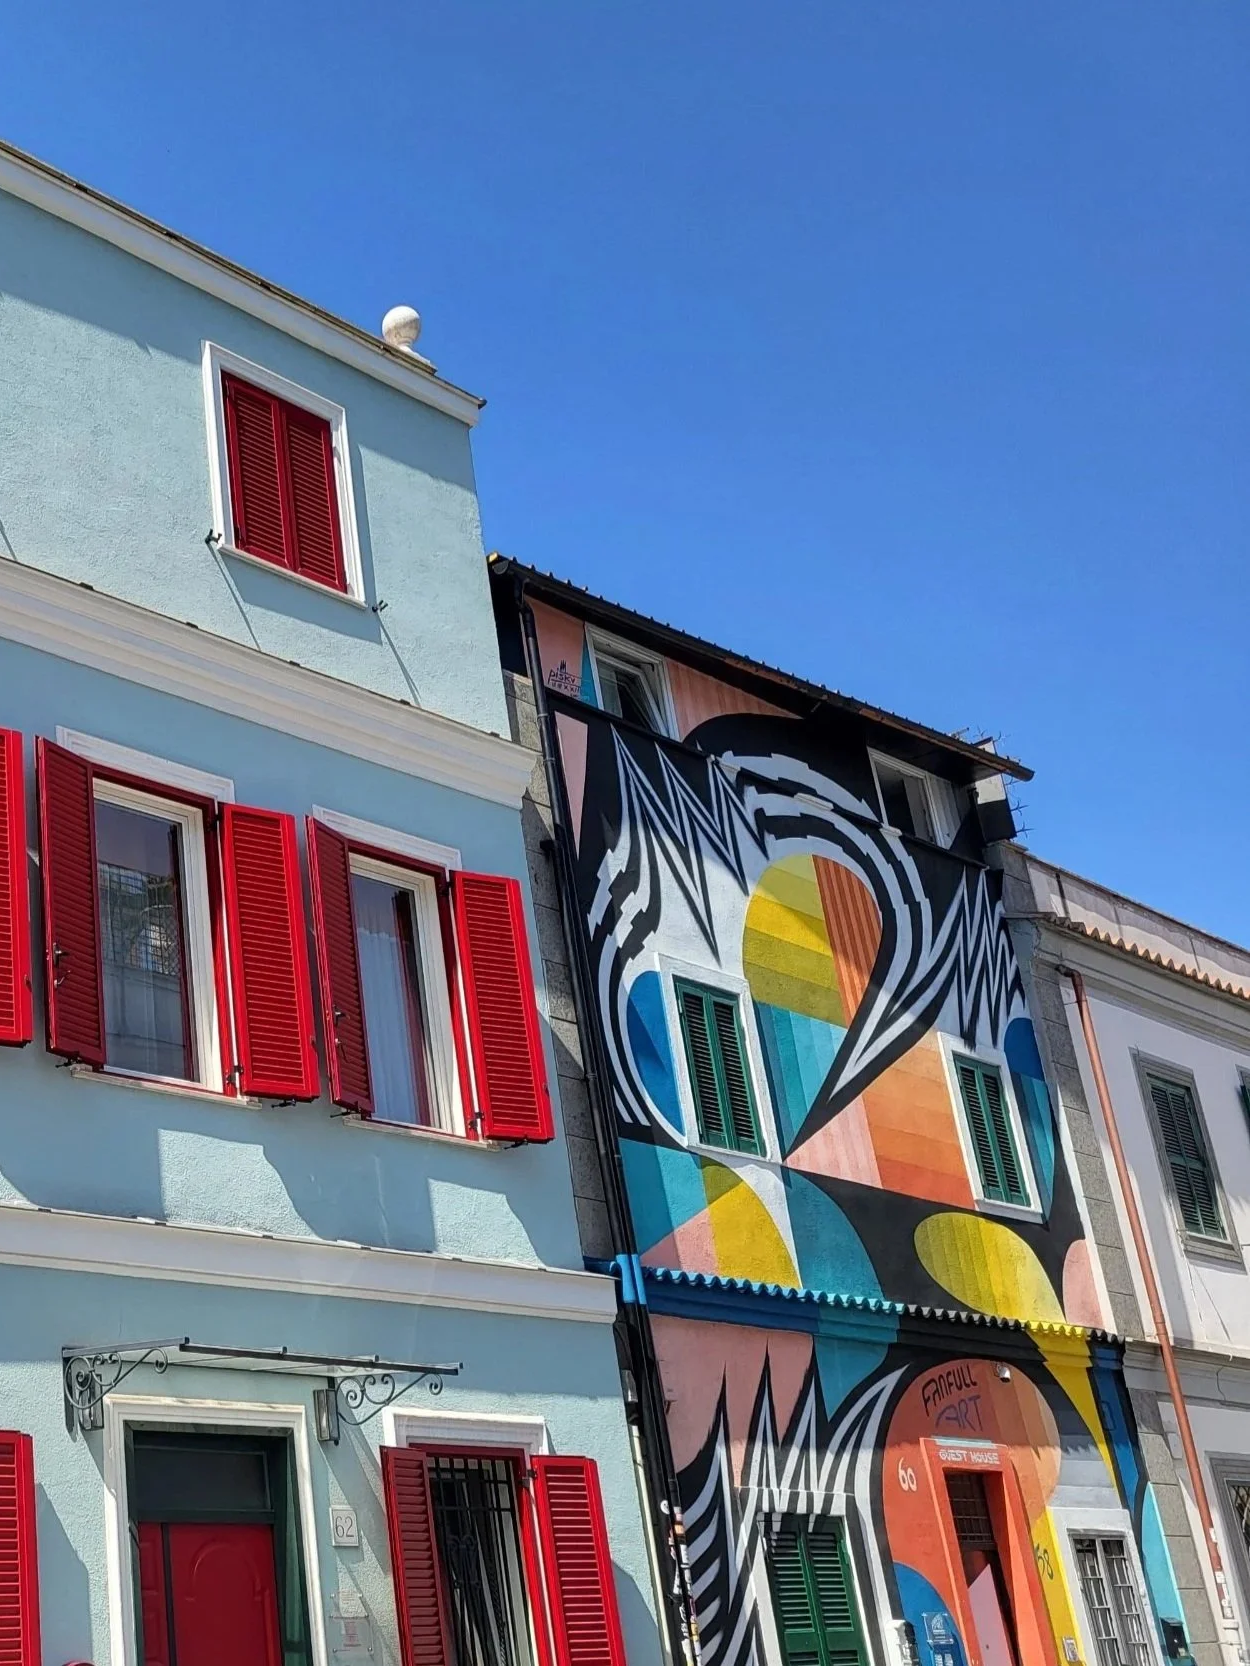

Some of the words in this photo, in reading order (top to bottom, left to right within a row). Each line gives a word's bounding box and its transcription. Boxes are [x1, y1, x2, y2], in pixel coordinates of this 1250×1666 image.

[921, 1363, 978, 1417] FANFULL
[935, 1394, 984, 1432] ART
[898, 1456, 918, 1492] 60
[938, 1449, 968, 1462] GUEST
[970, 1451, 1000, 1465] HOUSE
[335, 1515, 355, 1538] 62
